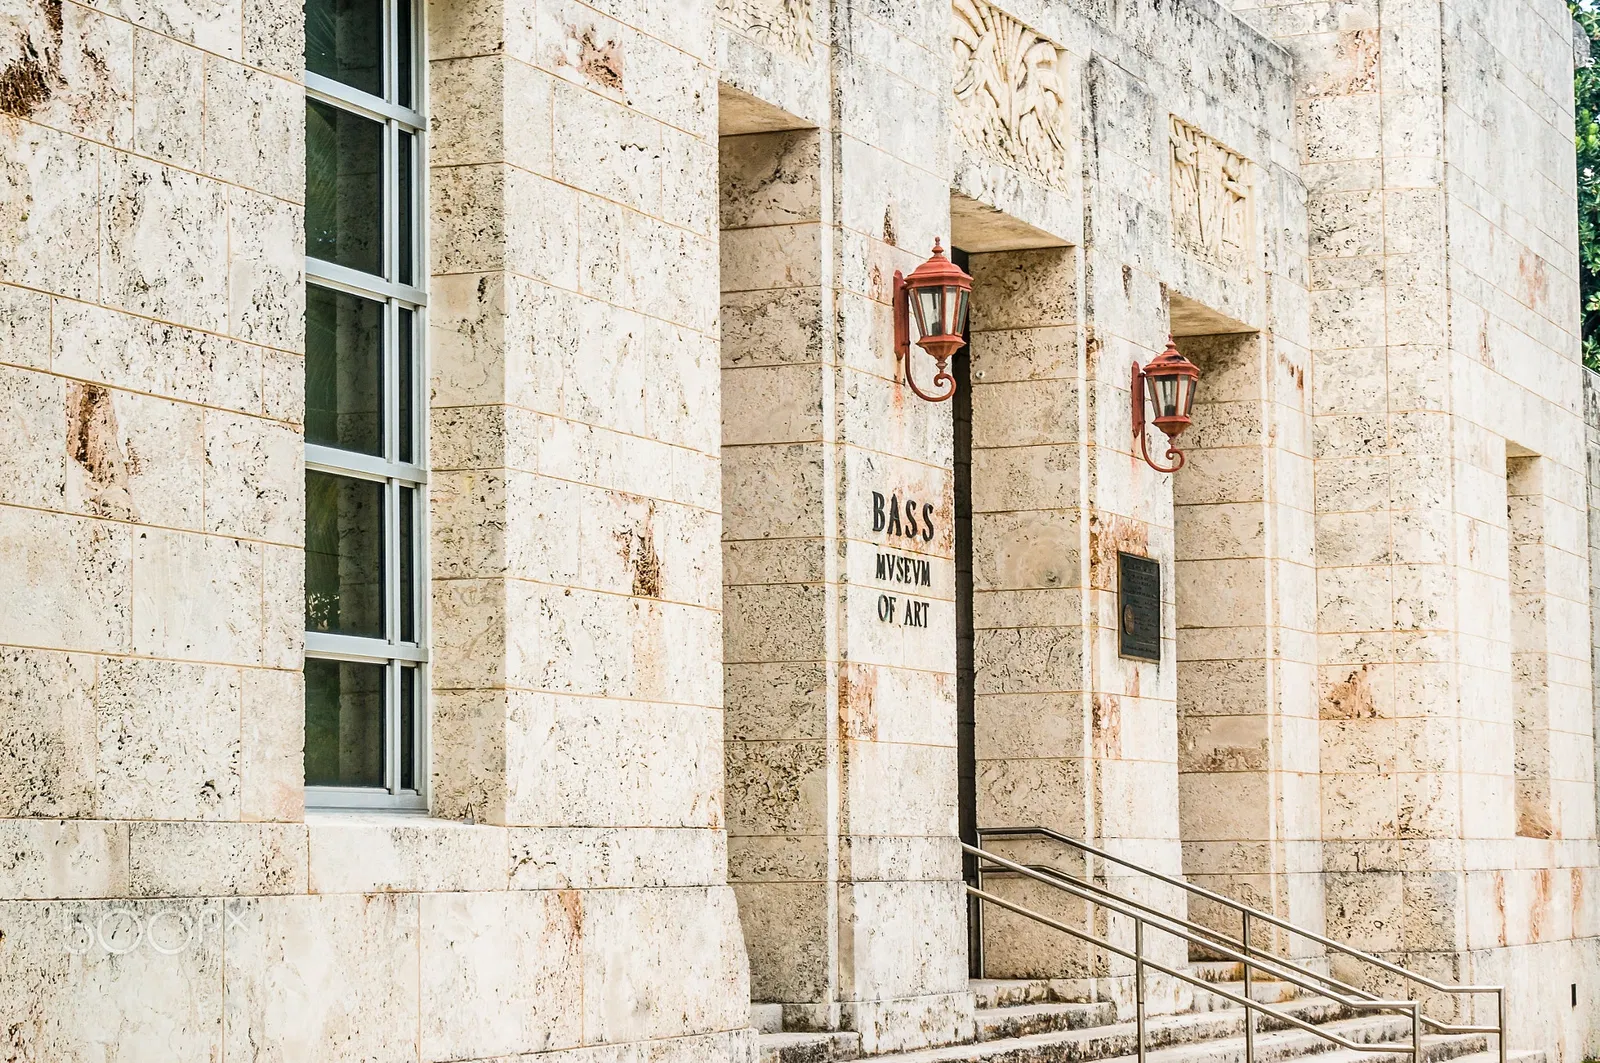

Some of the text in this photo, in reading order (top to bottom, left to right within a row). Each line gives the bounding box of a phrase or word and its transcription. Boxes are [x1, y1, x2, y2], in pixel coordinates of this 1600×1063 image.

[872, 491, 934, 542] BASS
[875, 553, 931, 587] MVSEVM
[877, 594, 930, 628] OF ART
